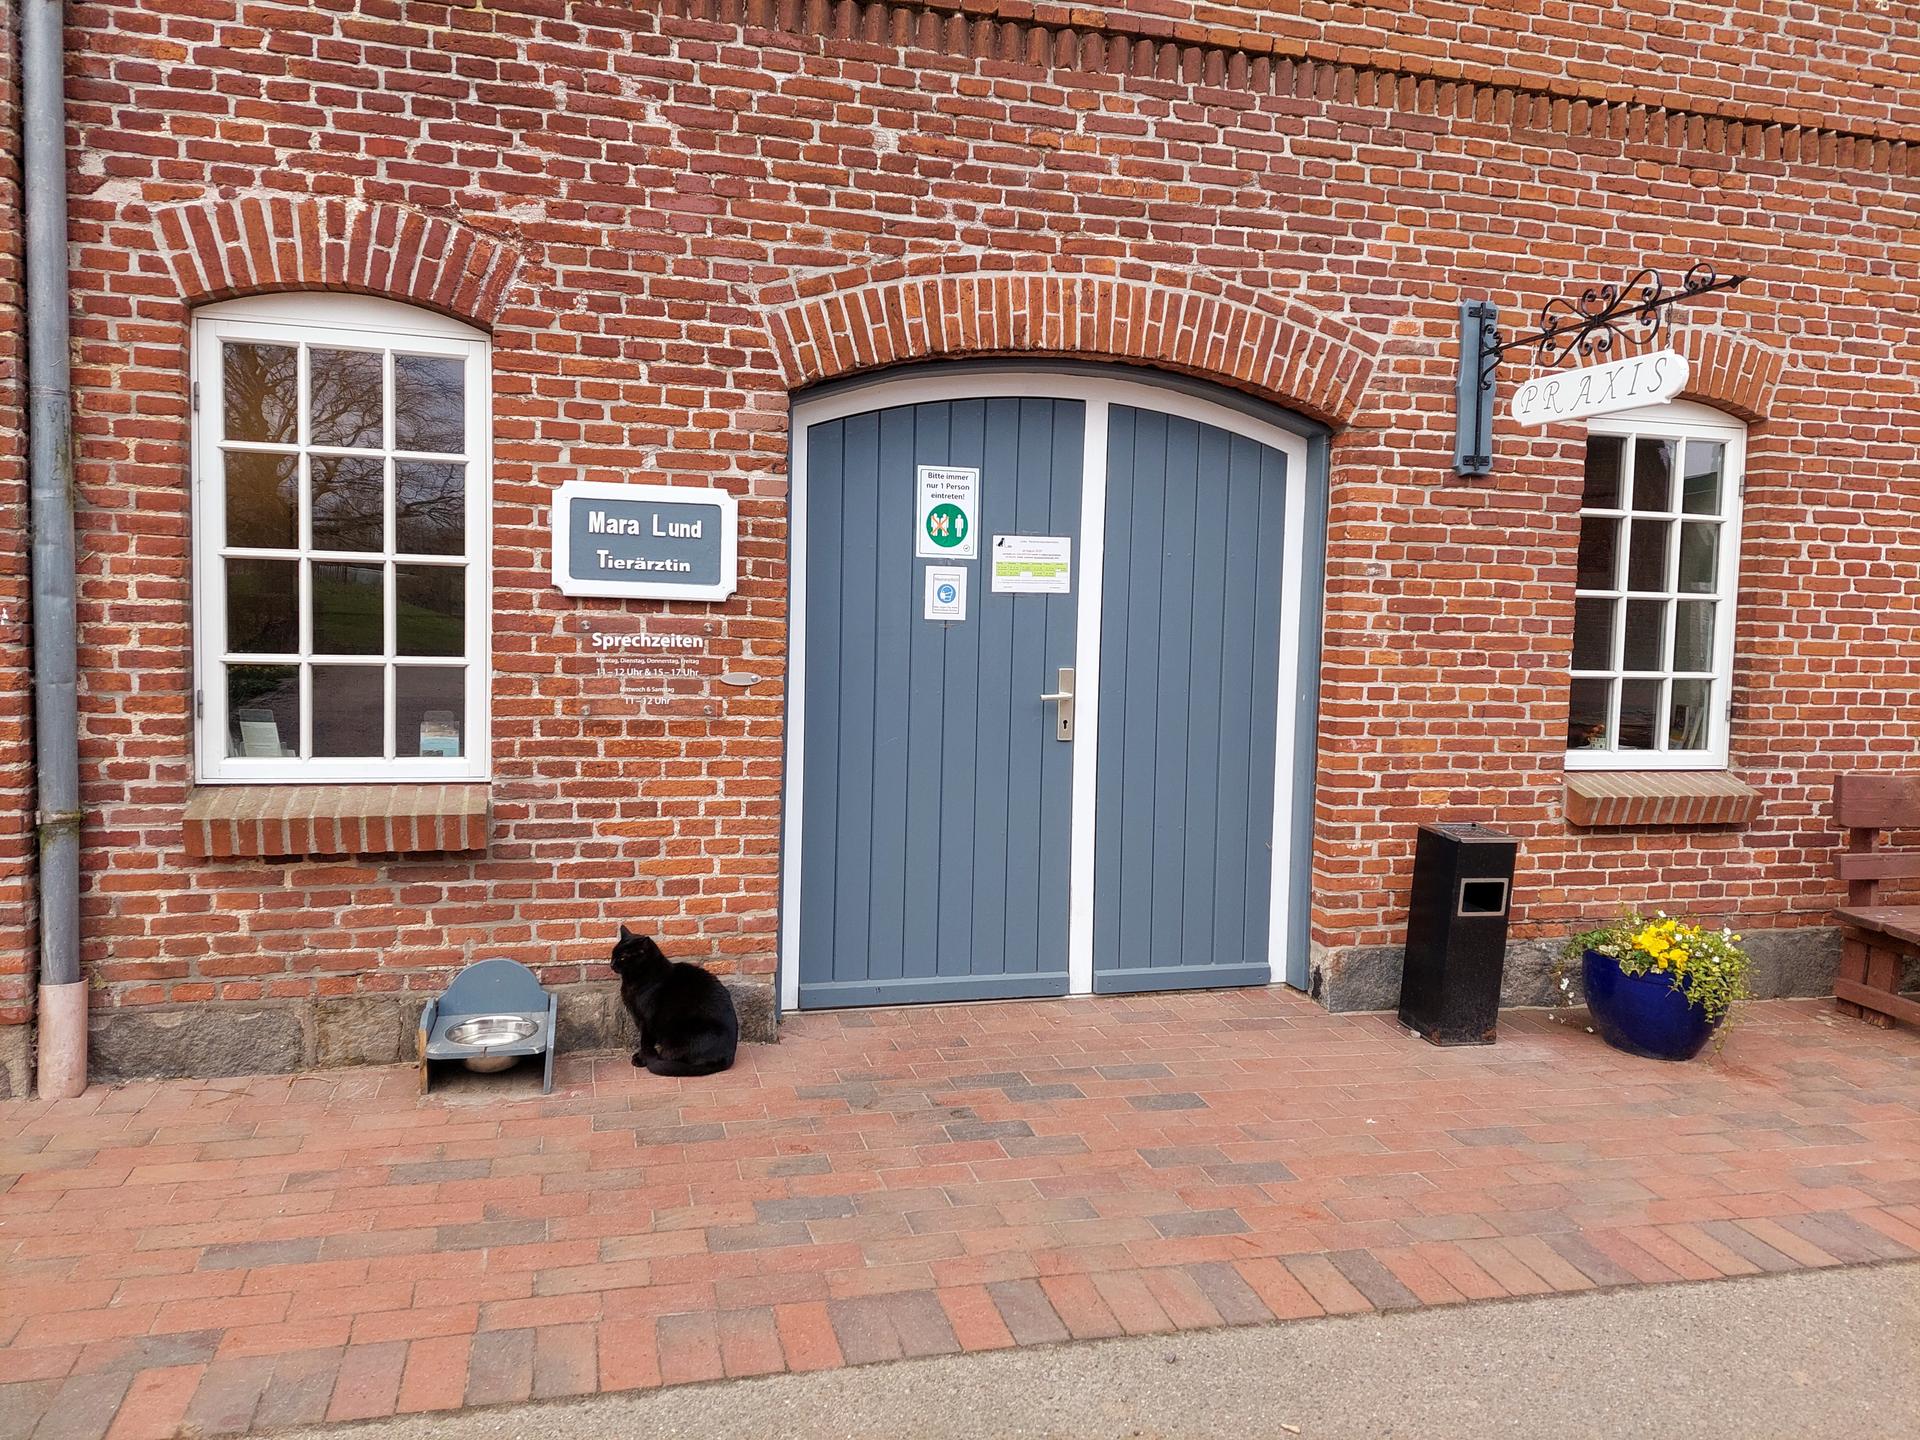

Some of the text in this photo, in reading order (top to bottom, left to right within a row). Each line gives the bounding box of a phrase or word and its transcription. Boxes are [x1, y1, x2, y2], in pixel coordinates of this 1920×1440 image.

[1521, 357, 1667, 414] PRAXIS
[945, 472, 969, 481] immer
[945, 482, 970, 491] Person
[930, 492, 965, 500] eintreten!
[588, 510, 702, 539] Mara Lund
[596, 549, 691, 573] Tierärztin
[592, 632, 704, 650] Sprechzeiten
[626, 668, 642, 676] Uhr
[644, 668, 652, 676] &
[654, 697, 671, 705] Uhr
